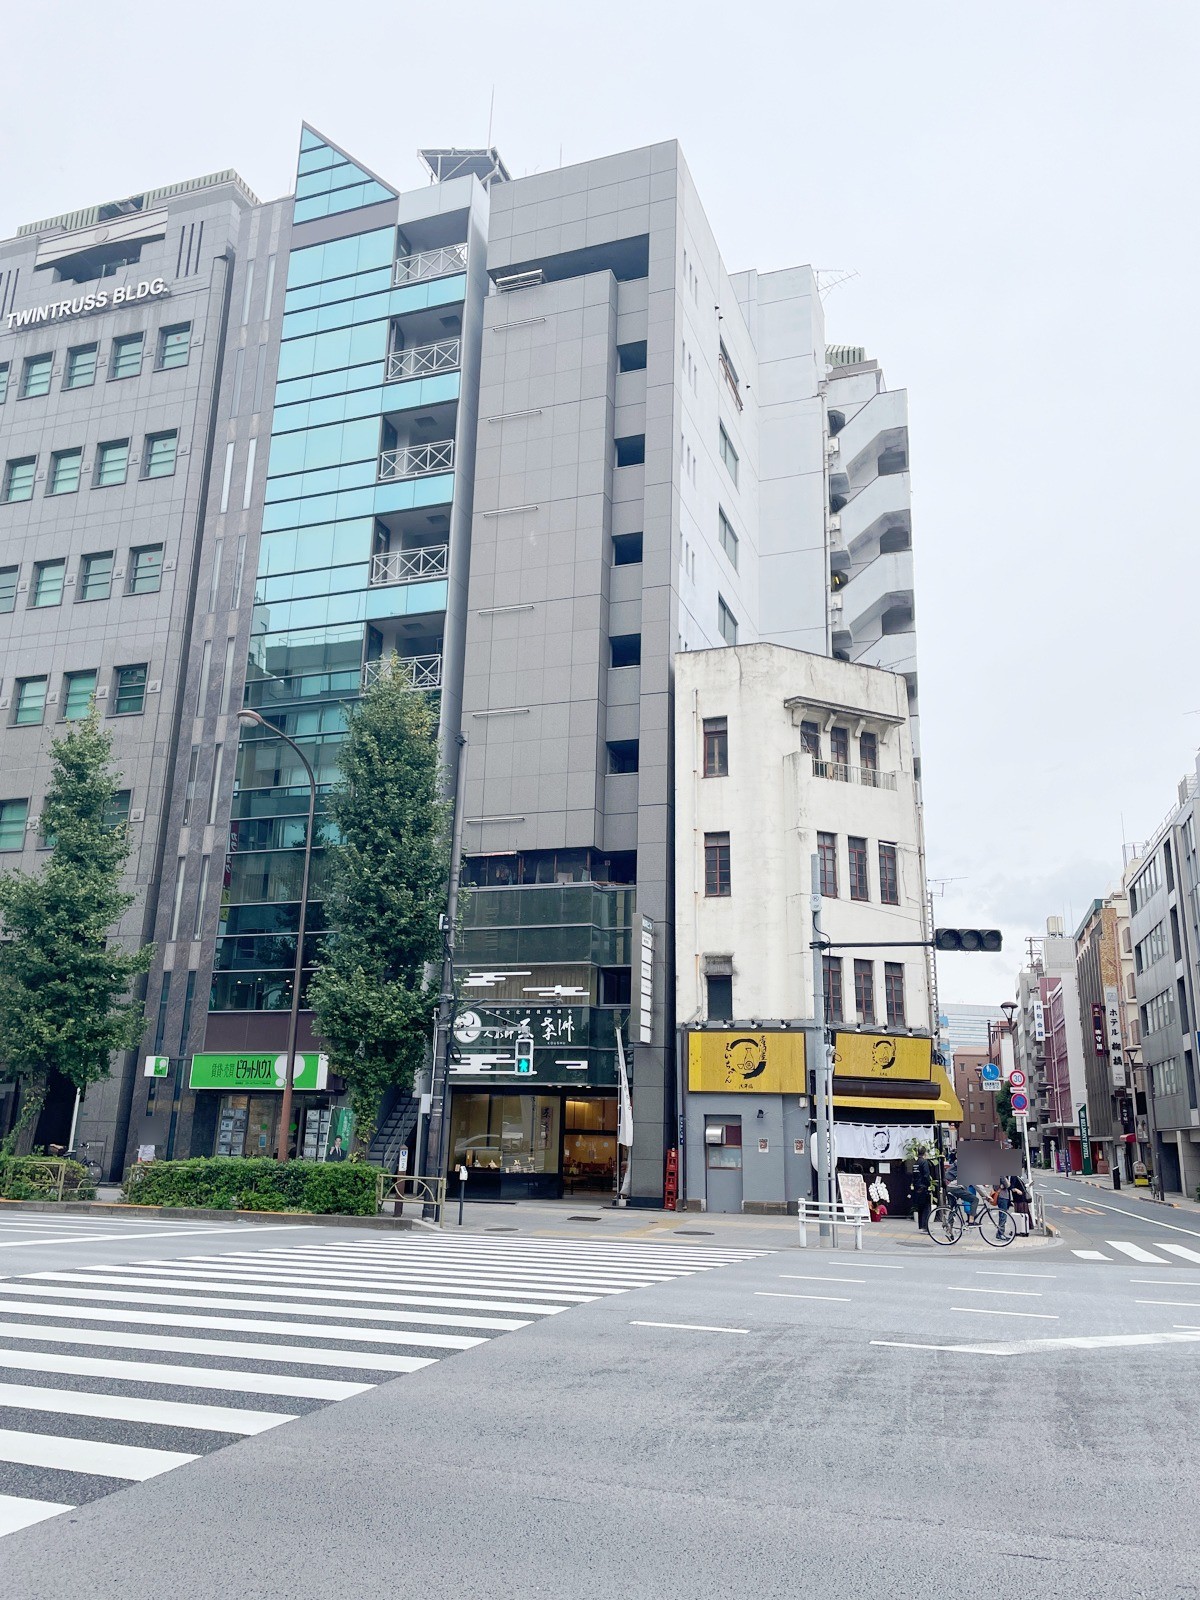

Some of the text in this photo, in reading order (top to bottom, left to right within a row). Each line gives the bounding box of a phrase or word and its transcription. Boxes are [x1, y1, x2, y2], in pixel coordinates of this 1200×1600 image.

[6, 277, 170, 329] TWINTRUSS BLDG.
[235, 1059, 272, 1079] ピタットハウス
[1013, 1074, 1023, 1083] 30
